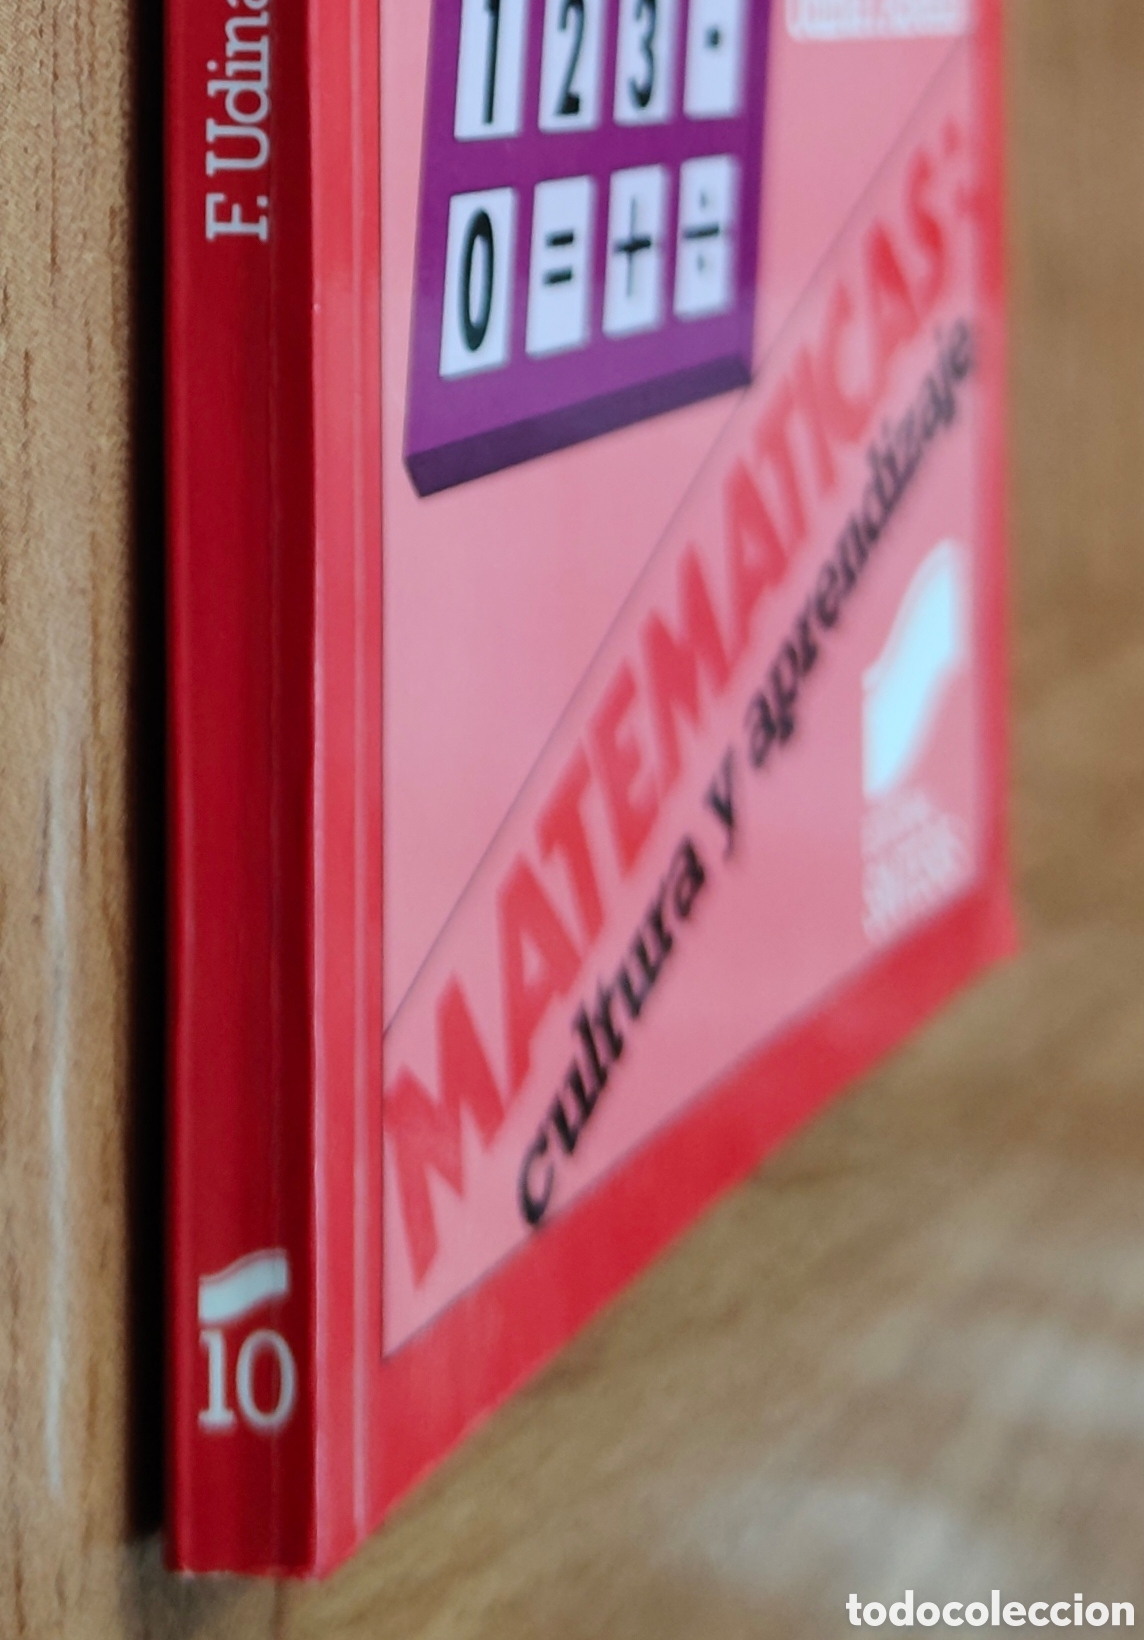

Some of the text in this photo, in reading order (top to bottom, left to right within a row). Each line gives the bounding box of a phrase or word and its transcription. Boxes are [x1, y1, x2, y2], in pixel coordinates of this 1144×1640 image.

[205, 192, 269, 242] F.
[459, 210, 493, 352] 0
[516, 833, 706, 1230] cultura
[704, 745, 738, 857] y
[745, 313, 976, 772] aprendizaje
[198, 1327, 298, 1432] 10
